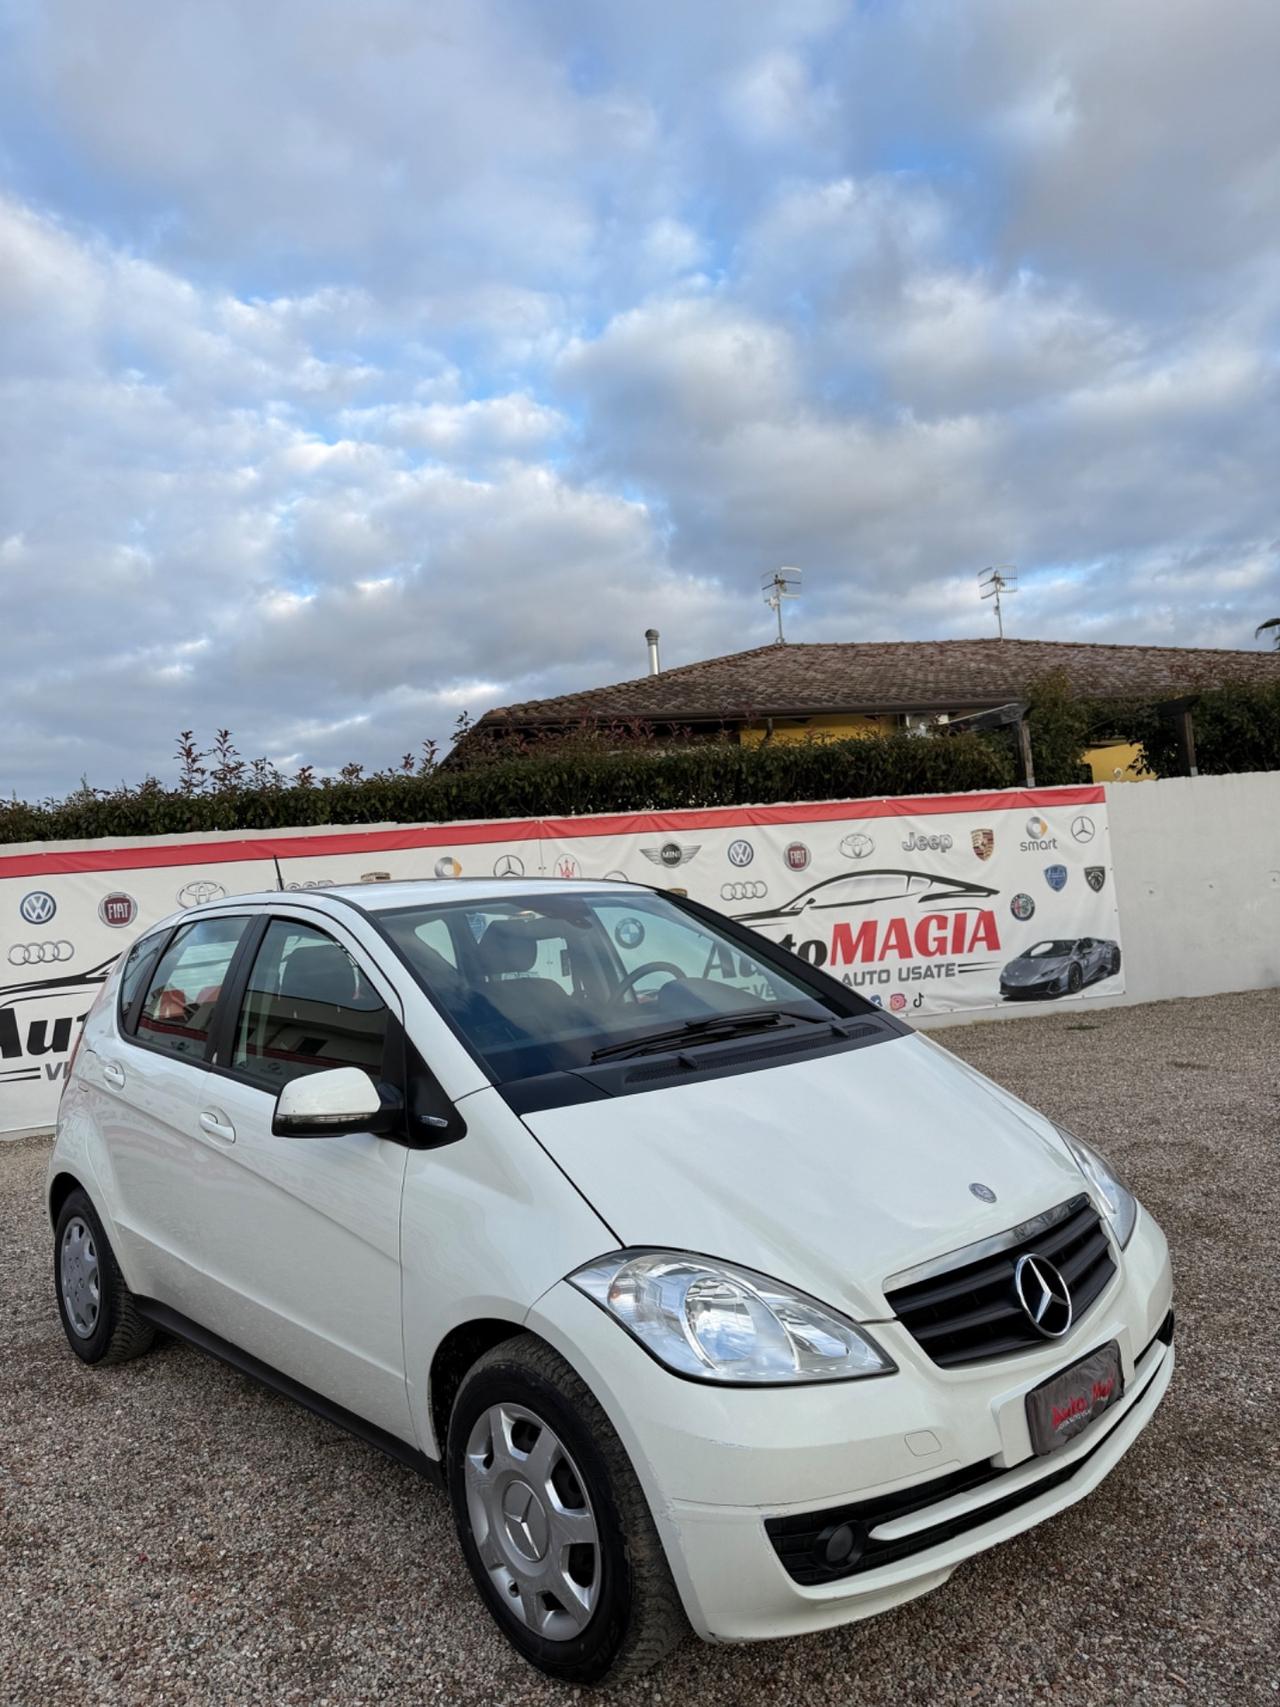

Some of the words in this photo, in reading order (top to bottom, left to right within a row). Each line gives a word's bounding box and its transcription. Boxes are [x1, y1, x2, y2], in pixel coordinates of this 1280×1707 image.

[901, 832, 953, 853] Jeep
[1019, 838, 1058, 852] smart
[107, 902, 129, 919] FIAT
[842, 969, 891, 987] AUTO
[897, 962, 956, 983] USATE
